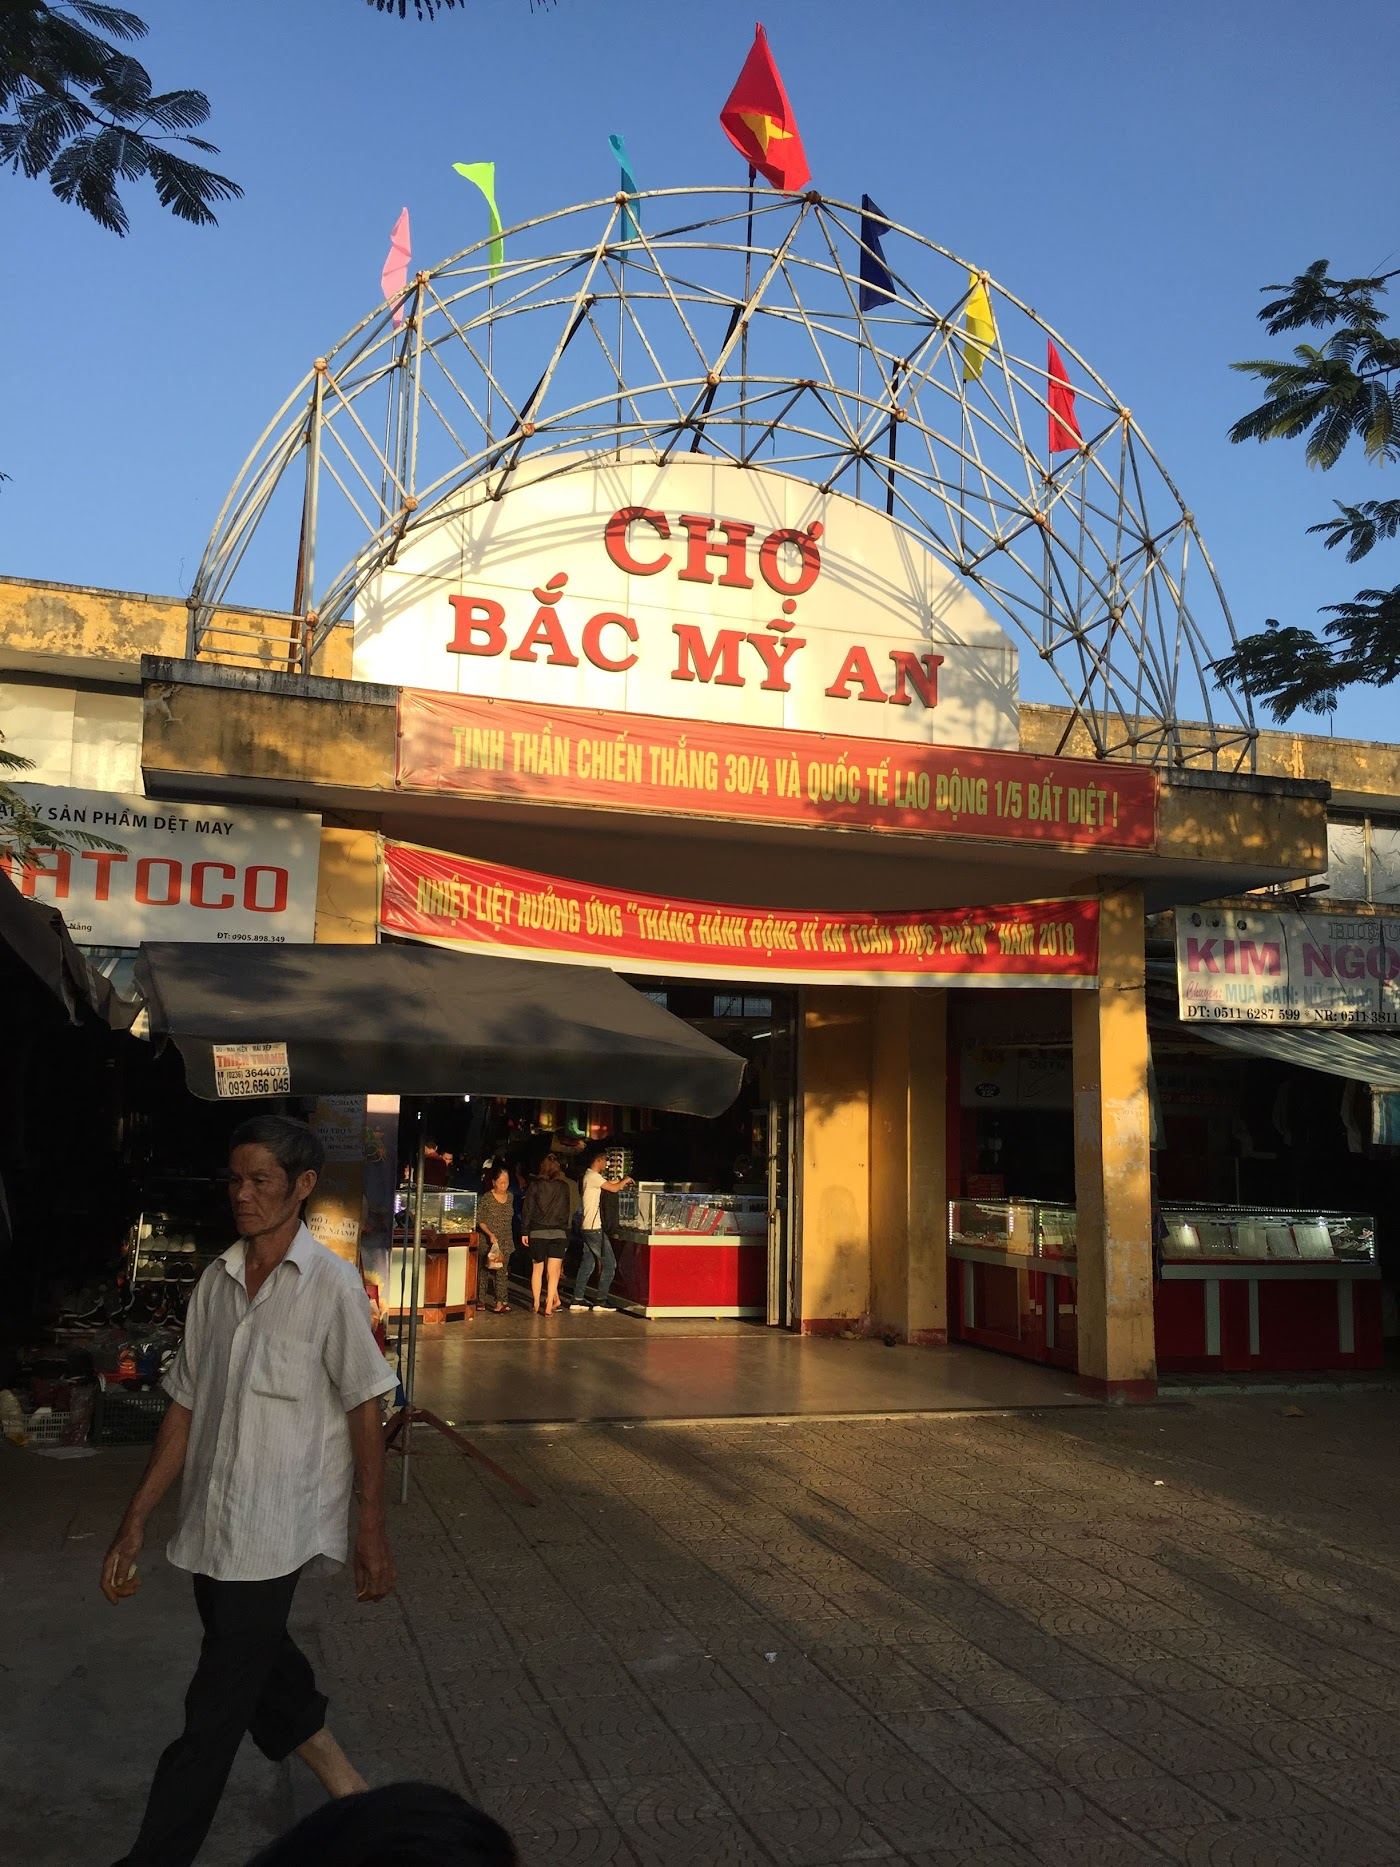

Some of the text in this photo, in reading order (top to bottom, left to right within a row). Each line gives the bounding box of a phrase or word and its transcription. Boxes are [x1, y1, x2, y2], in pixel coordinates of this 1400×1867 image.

[605, 506, 824, 614] CHỢ
[446, 572, 944, 708] BẮC MỸ AN
[451, 726, 504, 771] TINH
[512, 721, 570, 776] THẦN
[577, 730, 642, 783] CHIẾN
[650, 734, 718, 790] THẮNG
[724, 754, 769, 795] 30/4
[776, 751, 801, 799] VÀ
[807, 751, 860, 805] QUỐC
[866, 757, 891, 808] TẾ
[895, 770, 930, 811] LAO
[936, 767, 988, 821] ĐỘNG
[995, 780, 1022, 819] 1/5
[1028, 771, 1061, 822] BẤT
[1068, 781, 1107, 834] DIỆT
[48, 805, 86, 823] SẢN
[93, 807, 147, 828] PHẨM
[154, 814, 189, 831] DỆT
[195, 820, 234, 836] MAY
[416, 875, 471, 926] NHIỆT
[476, 882, 513, 931] LIỆT
[518, 884, 580, 933] HƯỞNG
[585, 894, 623, 937] ỨNG
[700, 909, 746, 948] HÀNH
[750, 913, 798, 956] ĐỘNG
[802, 916, 819, 952] VÌ
[822, 922, 847, 954] AN
[849, 918, 893, 956] TOÀN
[895, 923, 938, 962] THỰC
[999, 917, 1035, 956] NĂM
[1039, 922, 1075, 957] 2018
[1187, 937, 1281, 976] KIM
[1225, 983, 1257, 1003] MUA
[1214, 1006, 1241, 1018] 0511
[1247, 1008, 1274, 1020] 6287
[1278, 1008, 1300, 1021] 599
[1314, 1009, 1338, 1021] NR:
[1341, 1010, 1366, 1022] 0511
[1371, 1011, 1397, 1023] 3811
[245, 1067, 288, 1078] 3644072
[272, 1078, 289, 1092] 045
